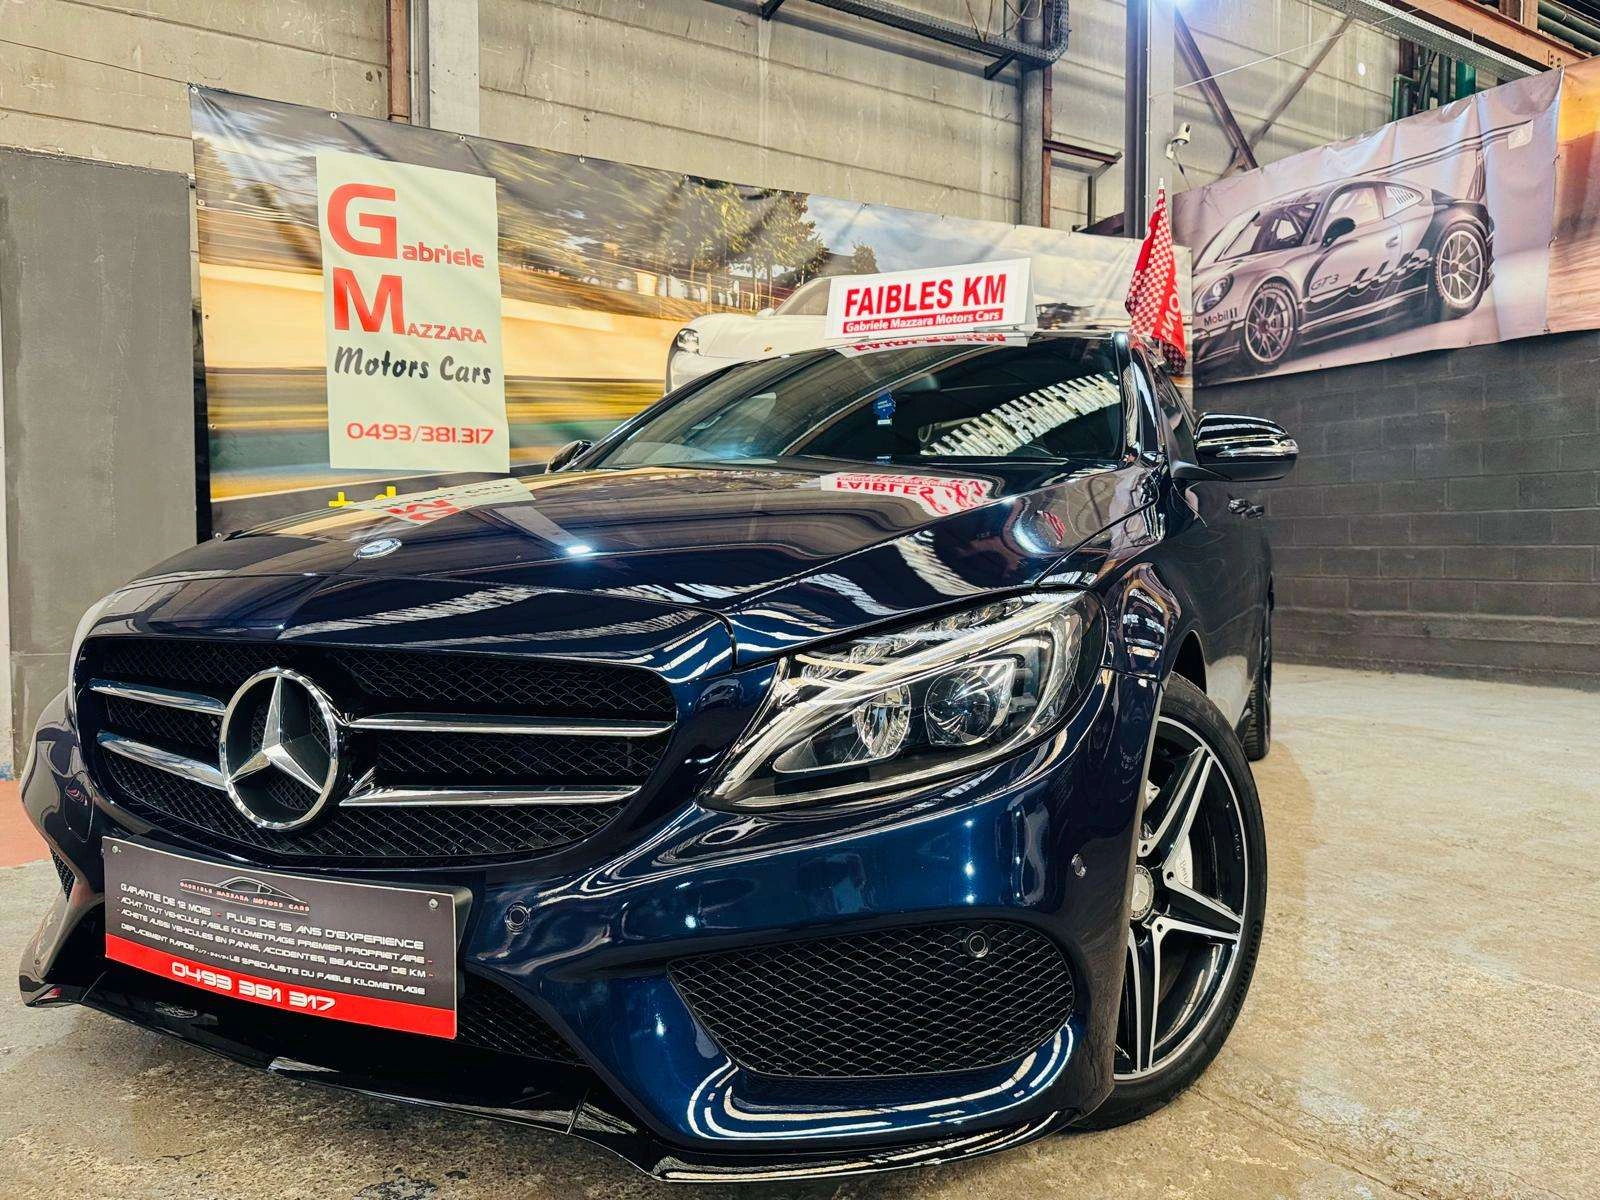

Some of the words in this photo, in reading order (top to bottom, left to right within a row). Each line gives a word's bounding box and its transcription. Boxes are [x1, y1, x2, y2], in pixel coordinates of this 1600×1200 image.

[327, 182, 485, 268] Gabriele
[333, 267, 487, 343] MAZZARA
[845, 279, 953, 317] FAIBLES
[962, 274, 1007, 307] KM
[846, 317, 888, 332] Gabriele
[890, 314, 933, 329] Mazzara
[935, 311, 973, 325] Motors
[975, 310, 999, 321] Cars
[334, 346, 429, 378] Motors
[440, 355, 492, 385] Cars
[346, 423, 494, 445] 0493/381.317
[120, 883, 161, 902] GARANTIE
[163, 897, 176, 906] DE
[177, 900, 187, 909] 12
[188, 903, 212, 916] MOIS
[226, 912, 257, 926] PLUS
[260, 917, 276, 930] DE
[279, 921, 292, 932] 15
[295, 925, 322, 937] ANS
[325, 929, 424, 950] D'EXPERIENCE
[121, 896, 142, 909] ACHAT
[144, 904, 163, 915] TOUT
[164, 910, 200, 925] VEHICULE
[231, 926, 295, 946] KILOMETRAGE
[298, 939, 342, 952] PREMIER
[344, 946, 425, 964] PROPRIETAIRE
[121, 923, 168, 943] DEPLACEMENT
[169, 938, 195, 951] RAPIDE
[229, 954, 240, 963] LE
[301, 970, 315, 978] DU
[353, 977, 426, 995] KILOMETRAGE
[149, 918, 171, 929] AUSSI
[172, 923, 214, 941] VEHICULES
[215, 935, 227, 944] EN
[329, 957, 389, 972] BEAUCOUP
[390, 966, 407, 975] DE
[408, 968, 426, 978] KM
[171, 961, 233, 991] 0493
[238, 980, 282, 1005] 381
[288, 992, 336, 1011] 317
